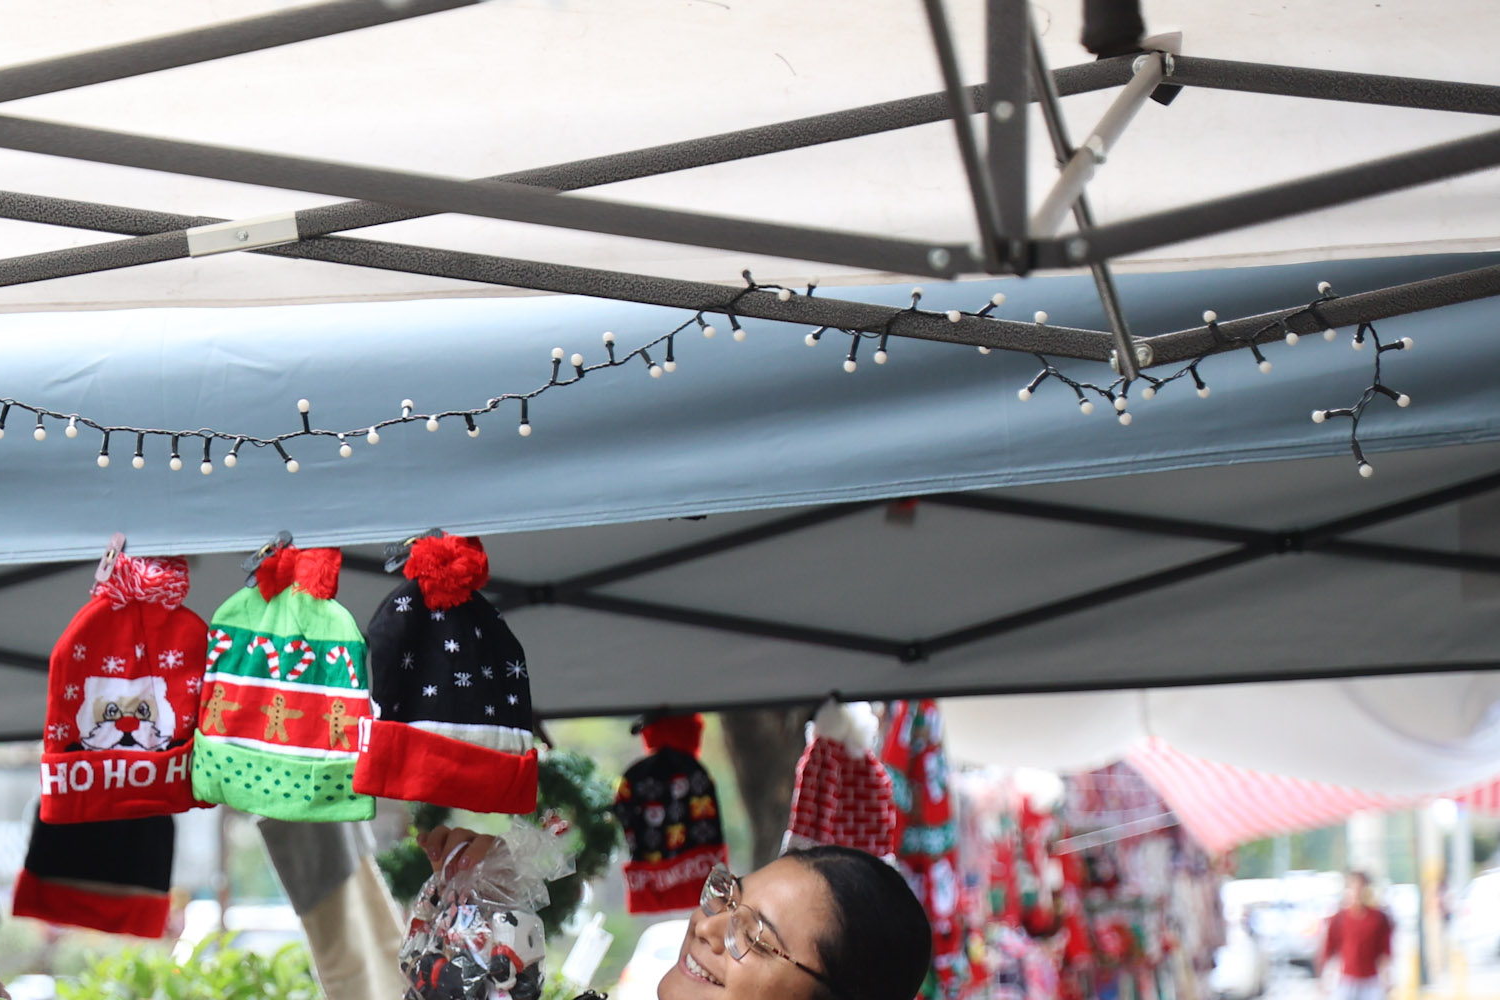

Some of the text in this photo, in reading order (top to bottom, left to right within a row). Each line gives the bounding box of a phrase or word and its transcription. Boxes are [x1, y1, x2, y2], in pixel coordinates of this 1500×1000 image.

[41, 752, 192, 795] HO HO H
